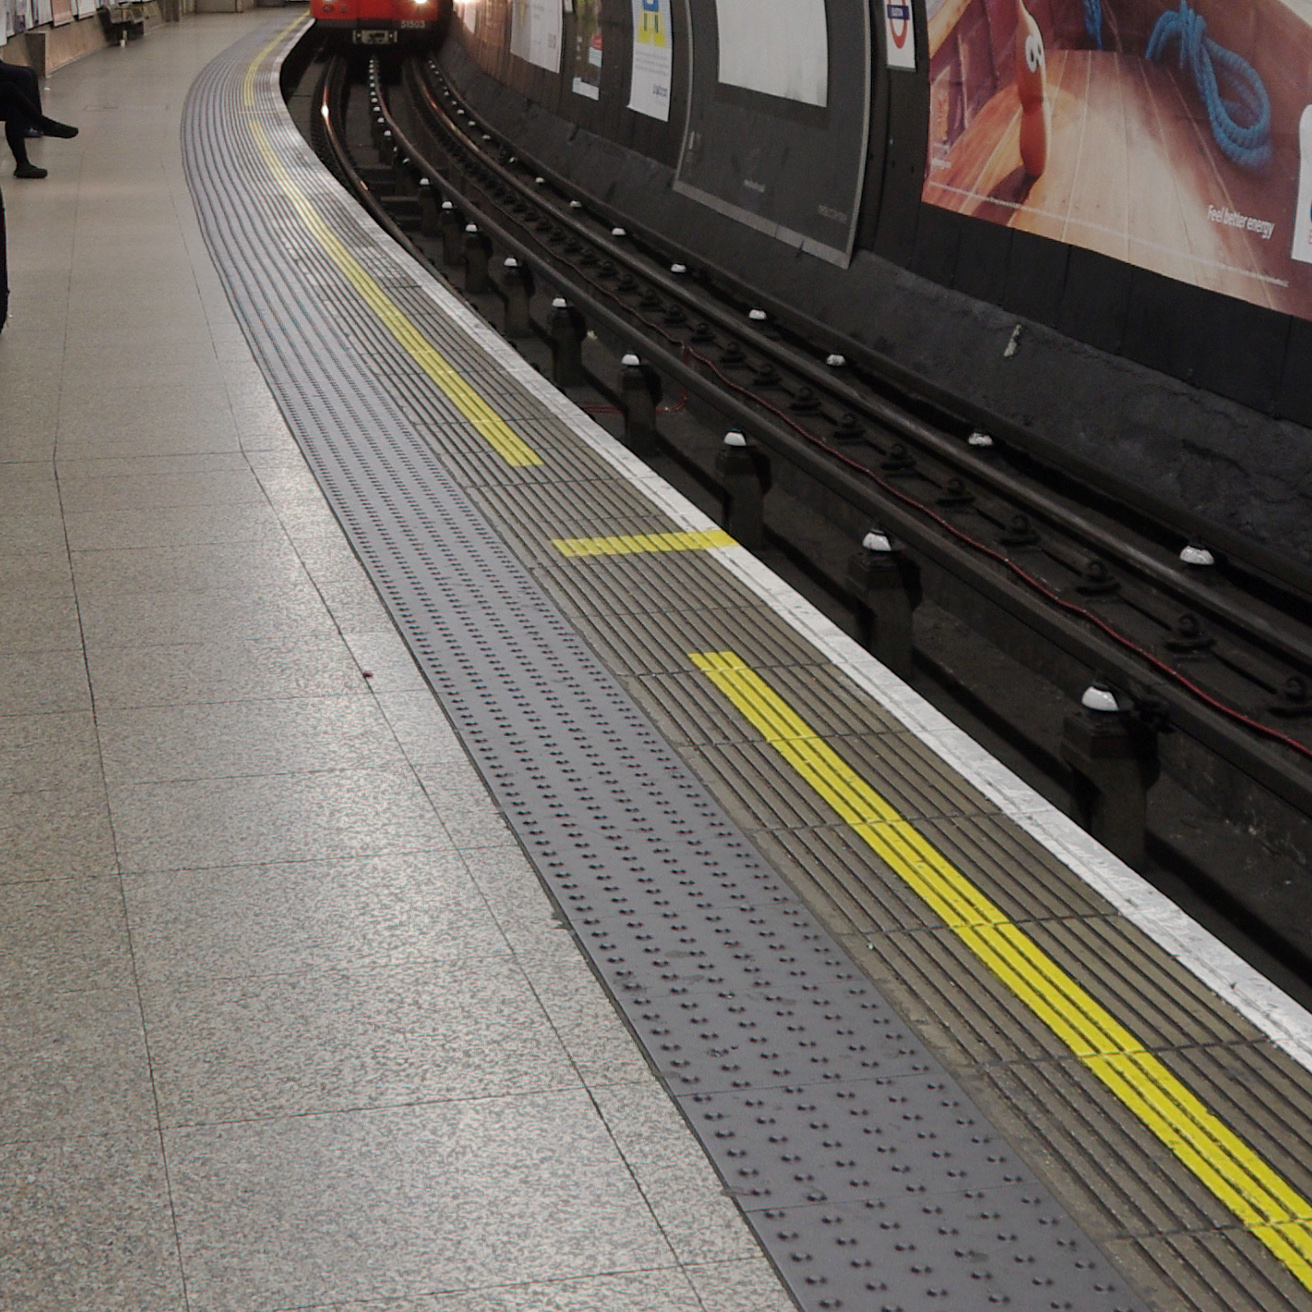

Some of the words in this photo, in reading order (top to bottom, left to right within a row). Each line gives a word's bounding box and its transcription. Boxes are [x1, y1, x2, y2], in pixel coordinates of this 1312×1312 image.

[1207, 204, 1226, 223] Feel
[1223, 207, 1249, 229] better
[1246, 217, 1276, 239] energy
